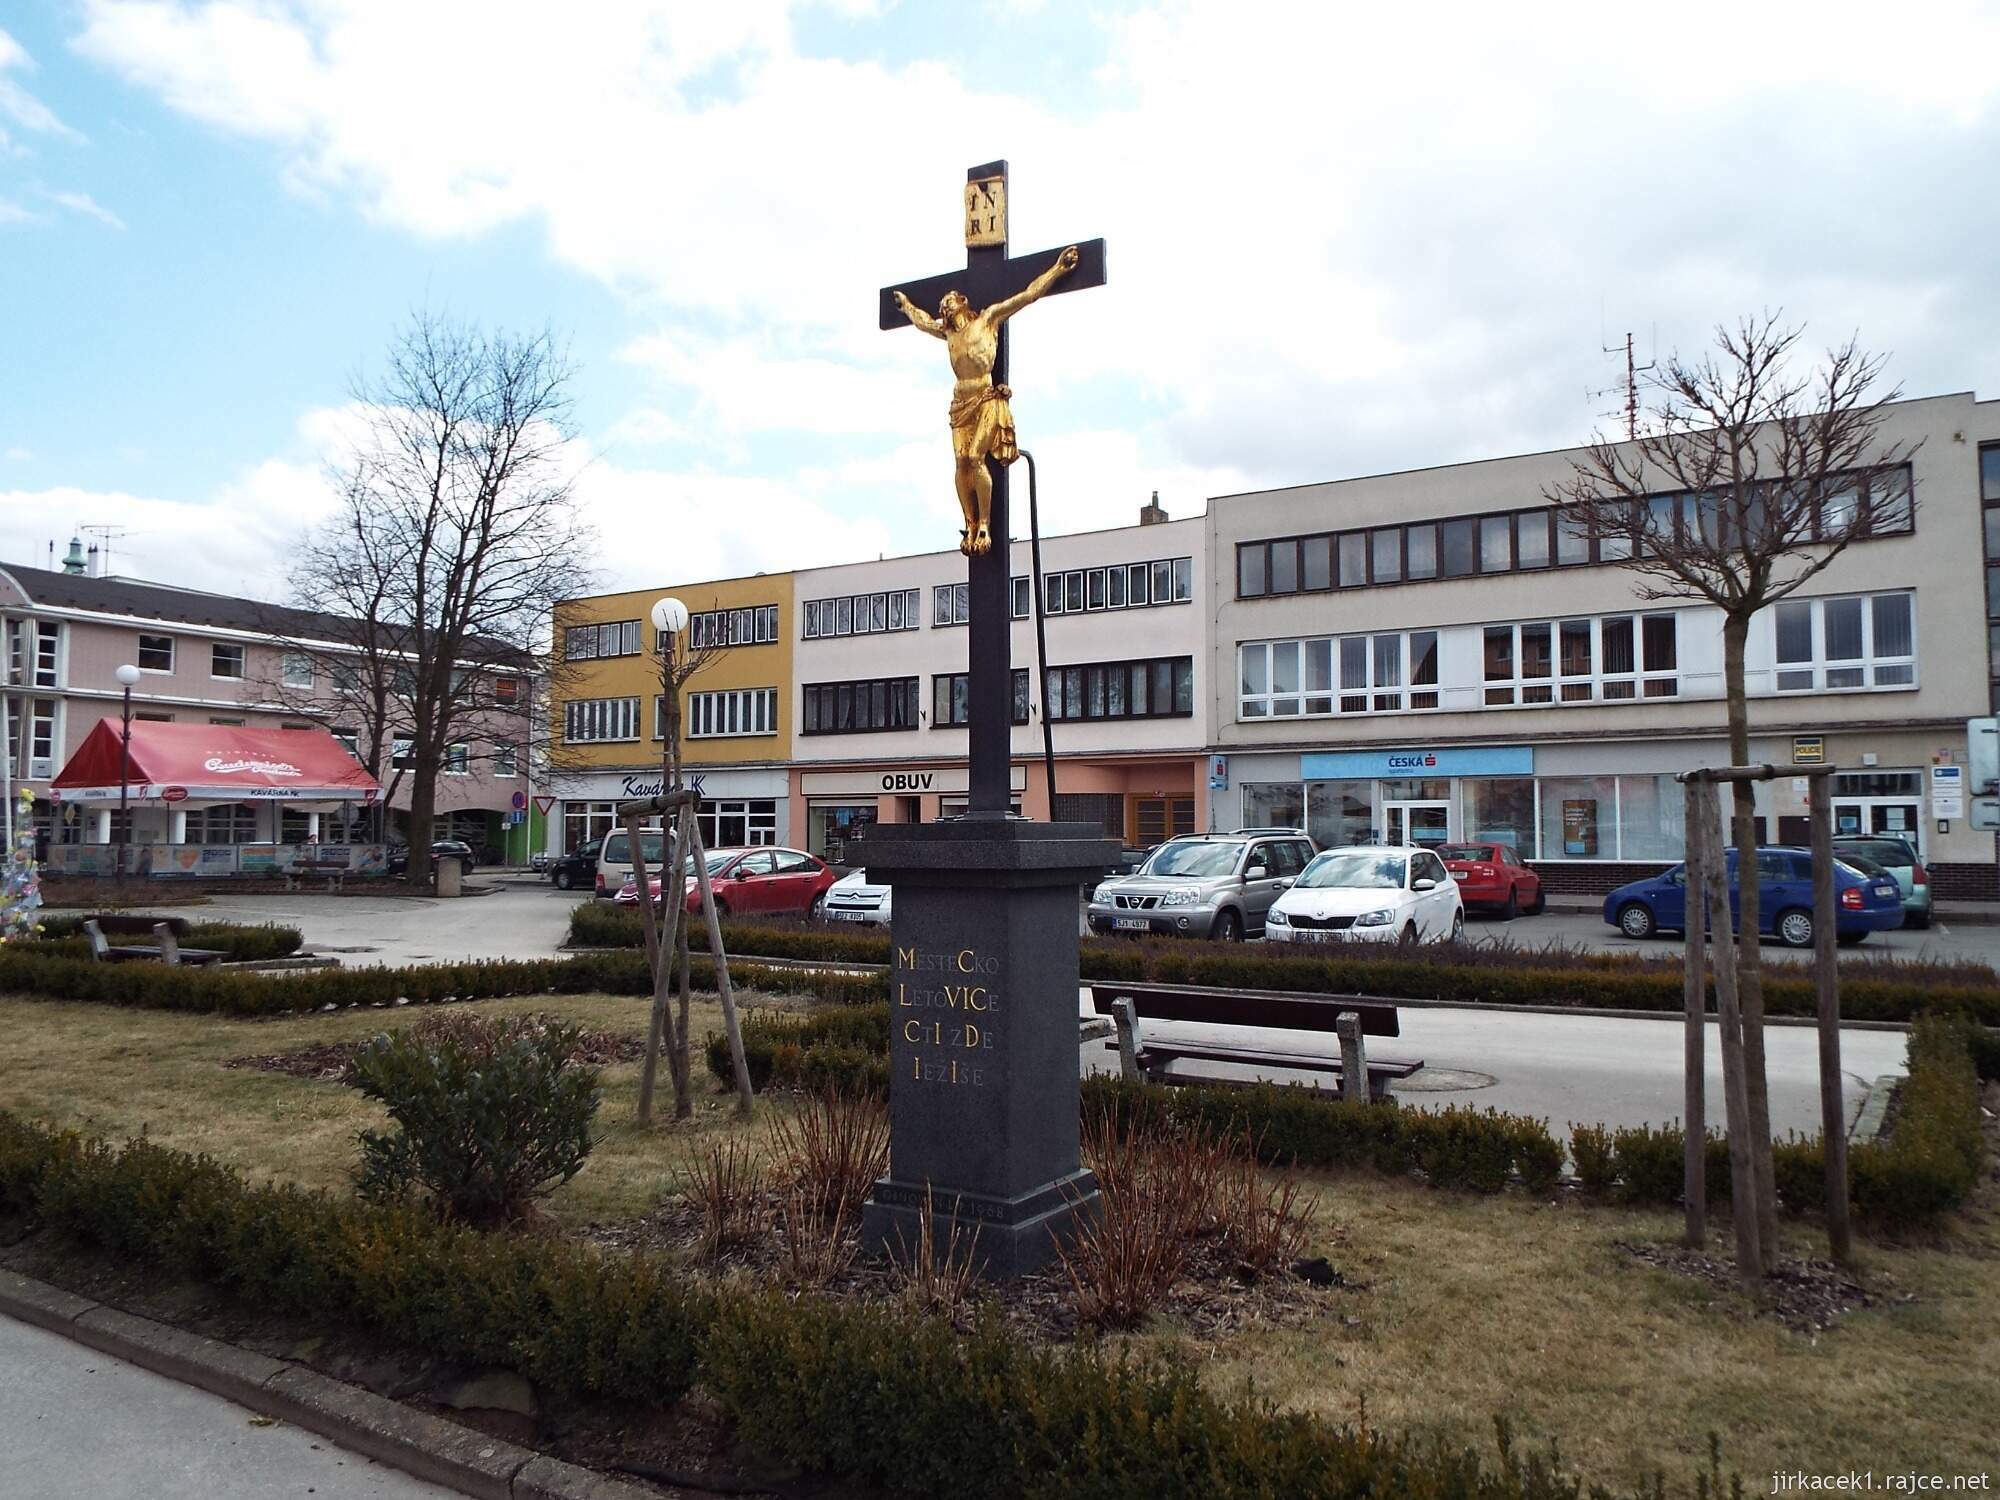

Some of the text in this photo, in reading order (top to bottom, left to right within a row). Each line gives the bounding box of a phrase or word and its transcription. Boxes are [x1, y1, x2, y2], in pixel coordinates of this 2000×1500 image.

[1388, 754, 1424, 767] ČESKÁ
[622, 775, 683, 796] Kavá
[882, 773, 933, 790] OBUV
[900, 983, 1000, 1012] LETOVICE
[951, 1024, 993, 1049] ZDE
